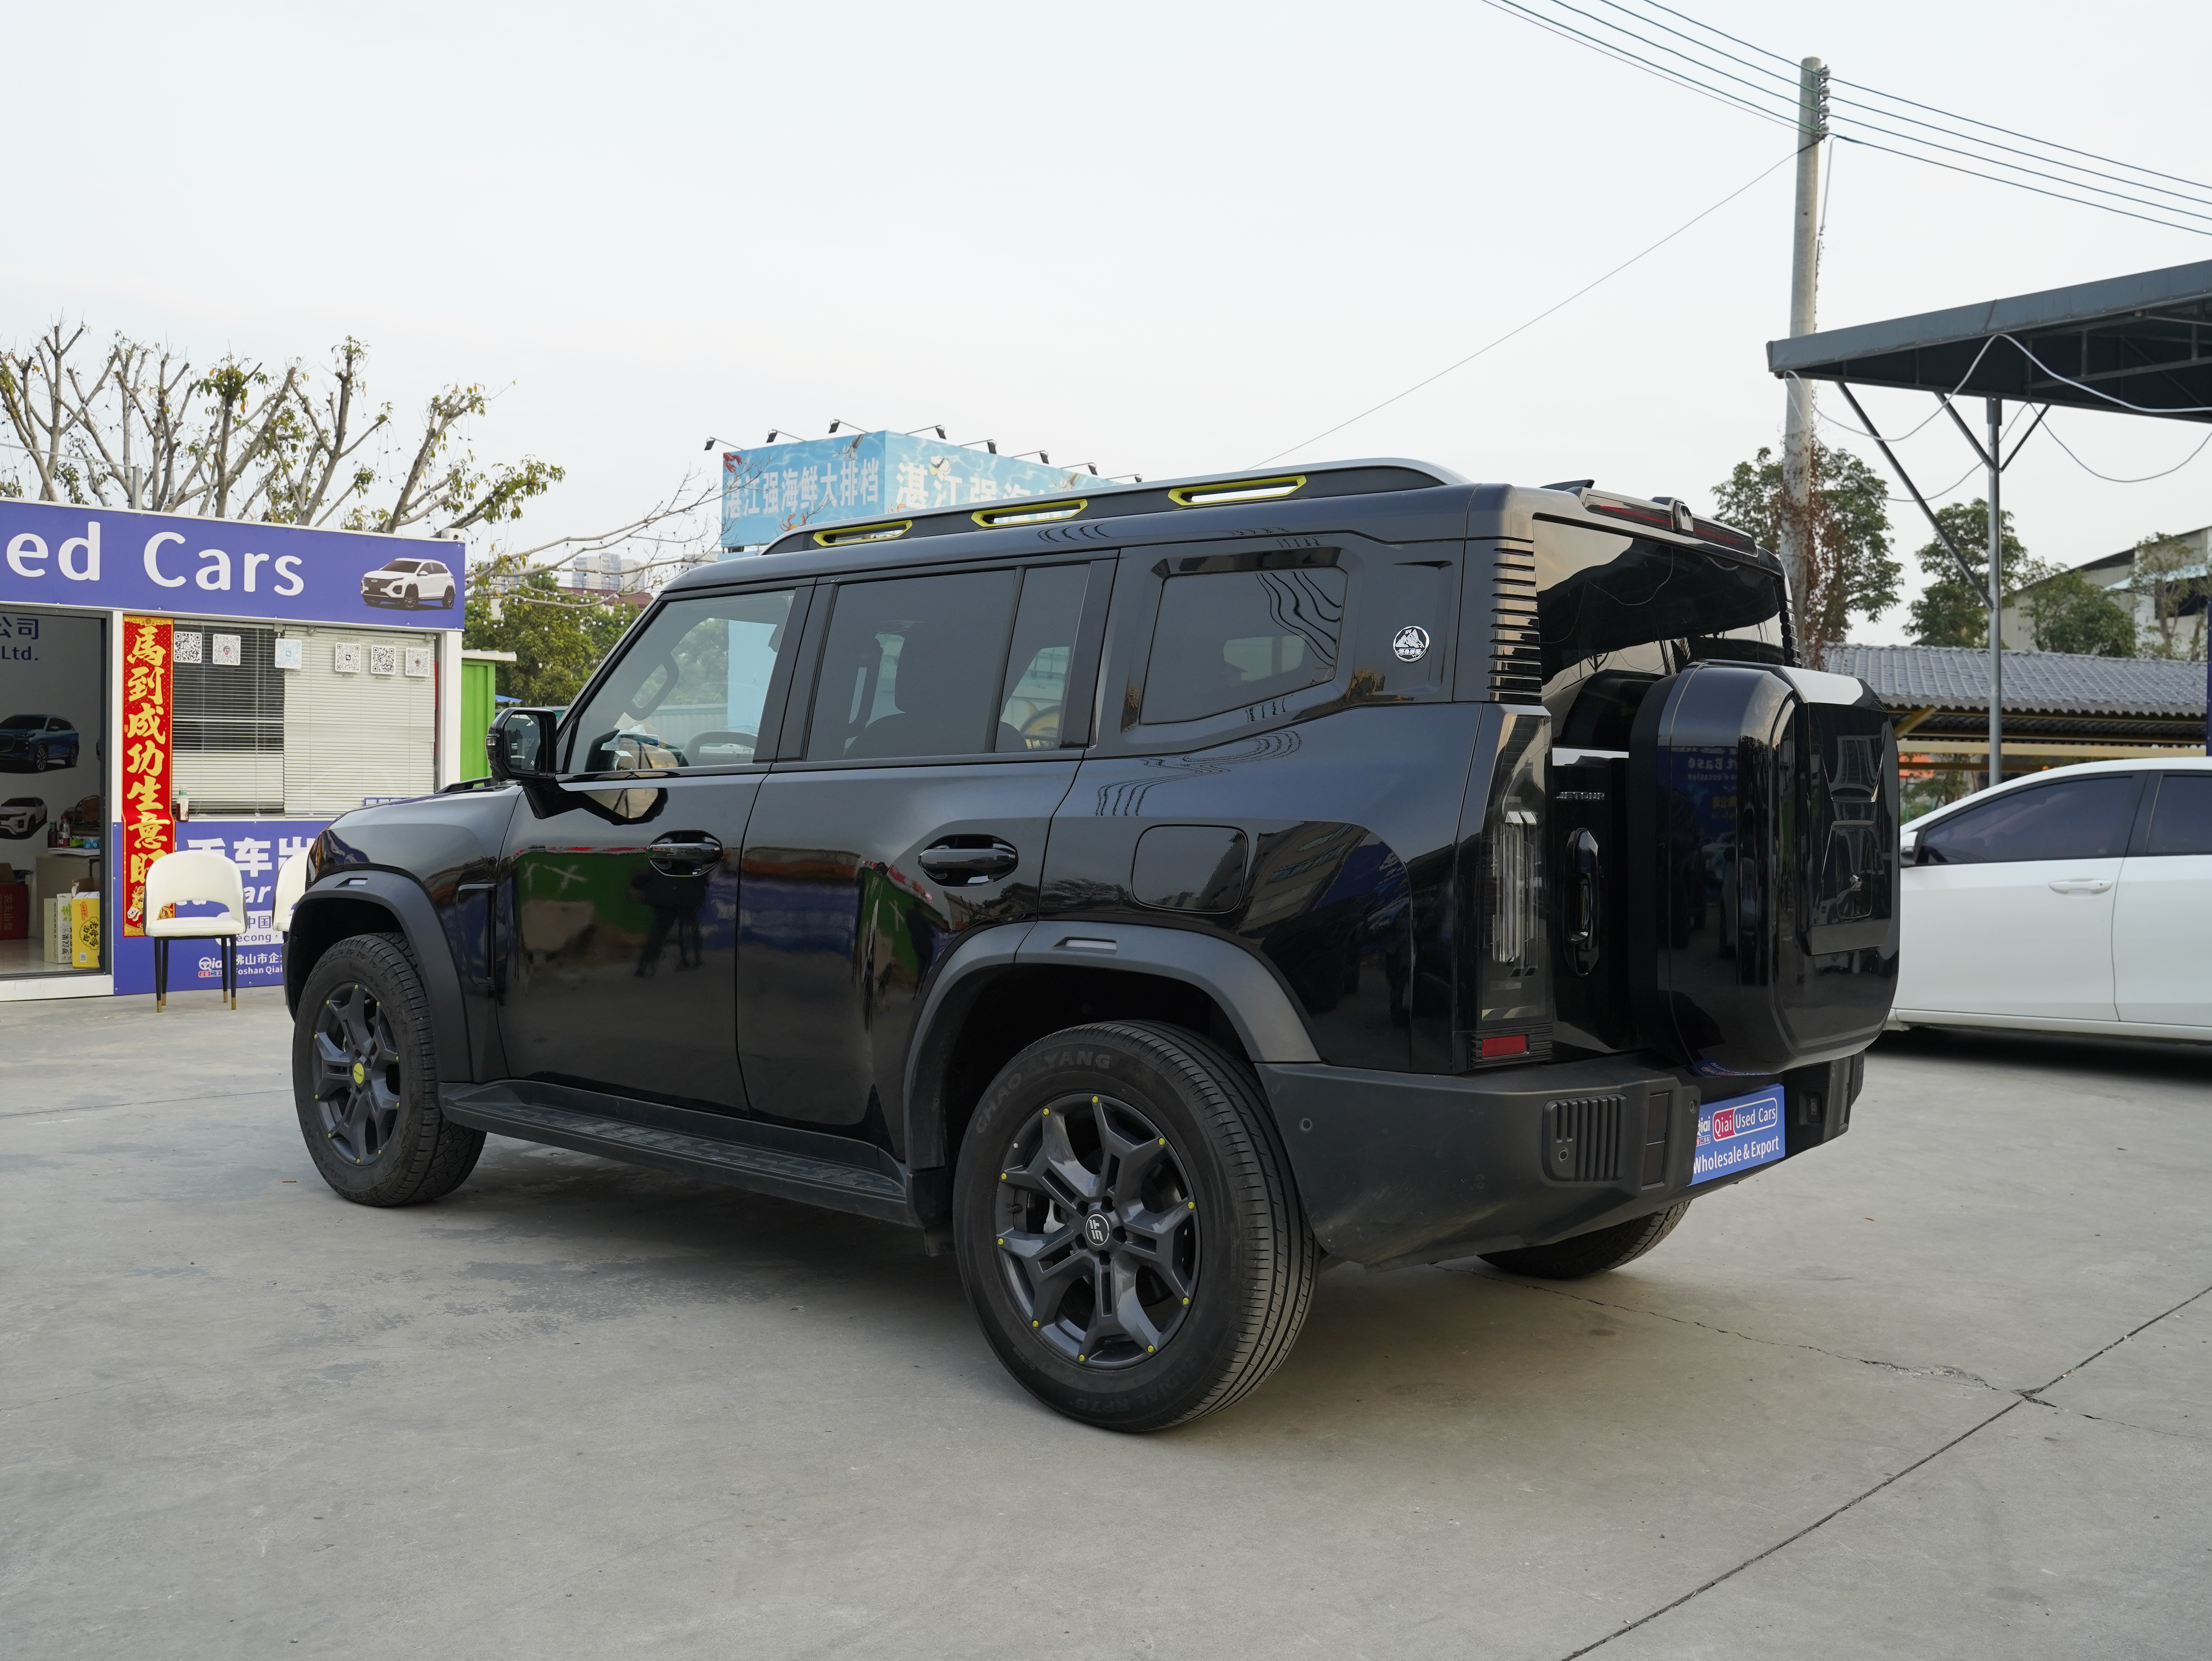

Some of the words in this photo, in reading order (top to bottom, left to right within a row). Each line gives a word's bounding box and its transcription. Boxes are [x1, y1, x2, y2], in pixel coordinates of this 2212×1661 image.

[725, 458, 879, 519] 湛江强海鲜大排档
[6, 522, 101, 581] ed
[144, 532, 305, 596] Cars
[0, 616, 39, 639] 公司
[2, 646, 39, 661] Ltd.
[244, 885, 272, 903] ar
[248, 916, 271, 929] 中国
[230, 934, 271, 943] econg
[199, 957, 222, 971] Qia
[236, 952, 282, 965] 佛山市企
[236, 967, 264, 975] oshan
[1043, 1050, 1111, 1071] YANG
[1715, 1115, 1732, 1137] Qiai
[1735, 1109, 1755, 1129] Used
[1759, 1108, 1776, 1122] Cars
[1693, 1146, 1742, 1174] Wholesale
[1743, 1143, 1750, 1160] &
[1751, 1136, 1779, 1159] Export
